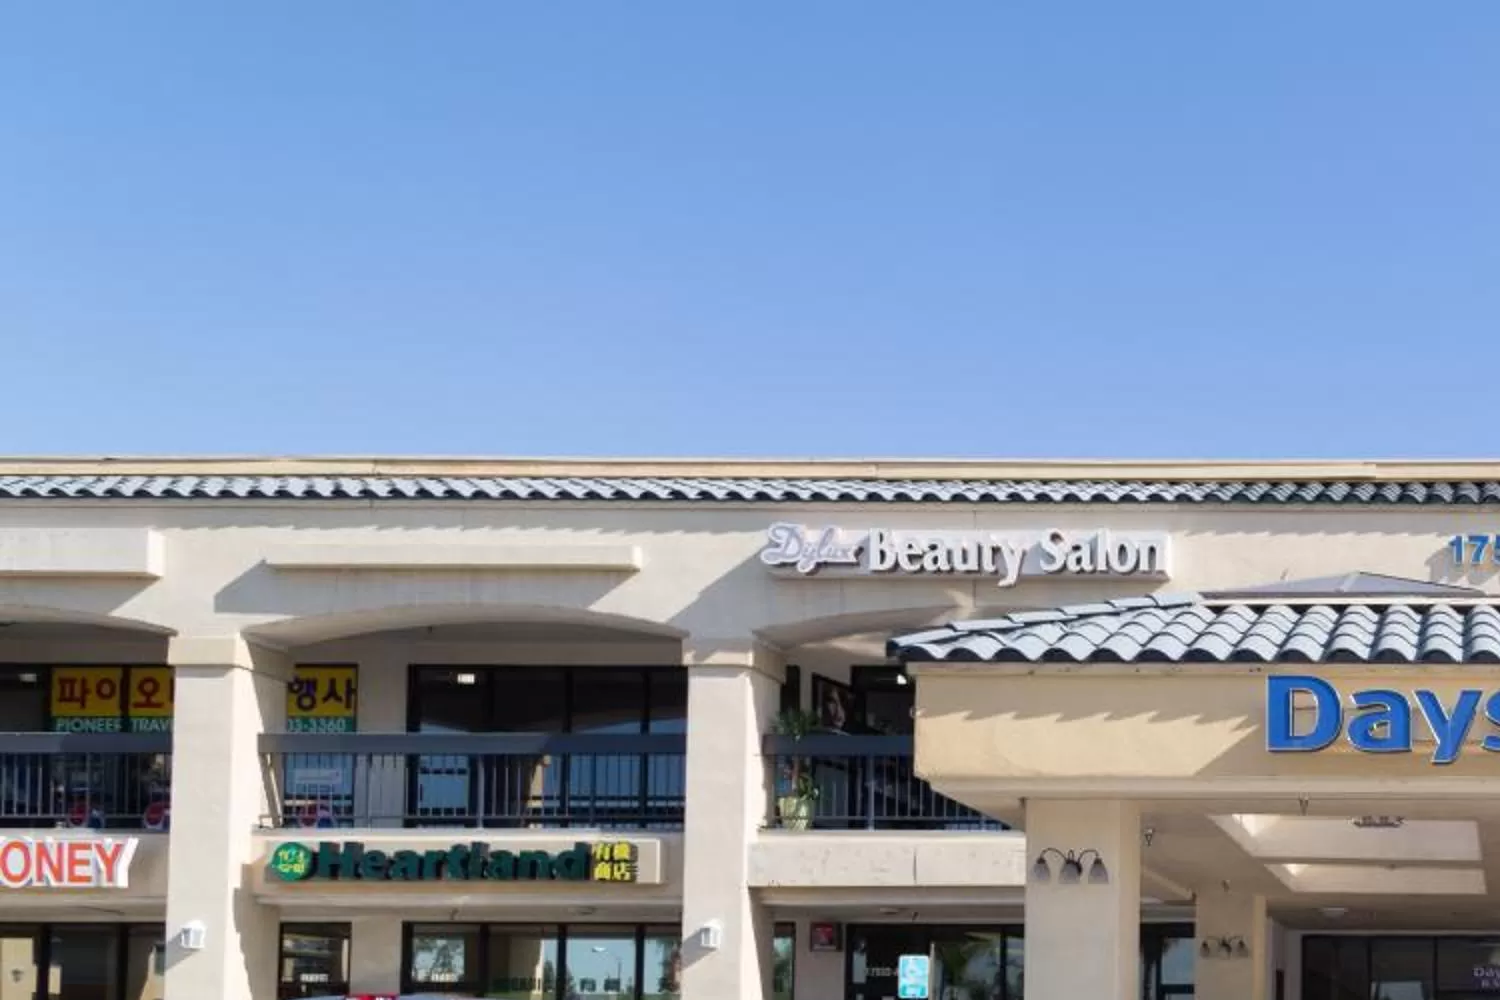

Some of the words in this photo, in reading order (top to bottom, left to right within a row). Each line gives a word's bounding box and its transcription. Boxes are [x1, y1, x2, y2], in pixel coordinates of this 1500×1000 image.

[868, 527, 1026, 587] Beauty
[1039, 527, 1168, 574] Salon
[316, 841, 592, 881] Heartland
